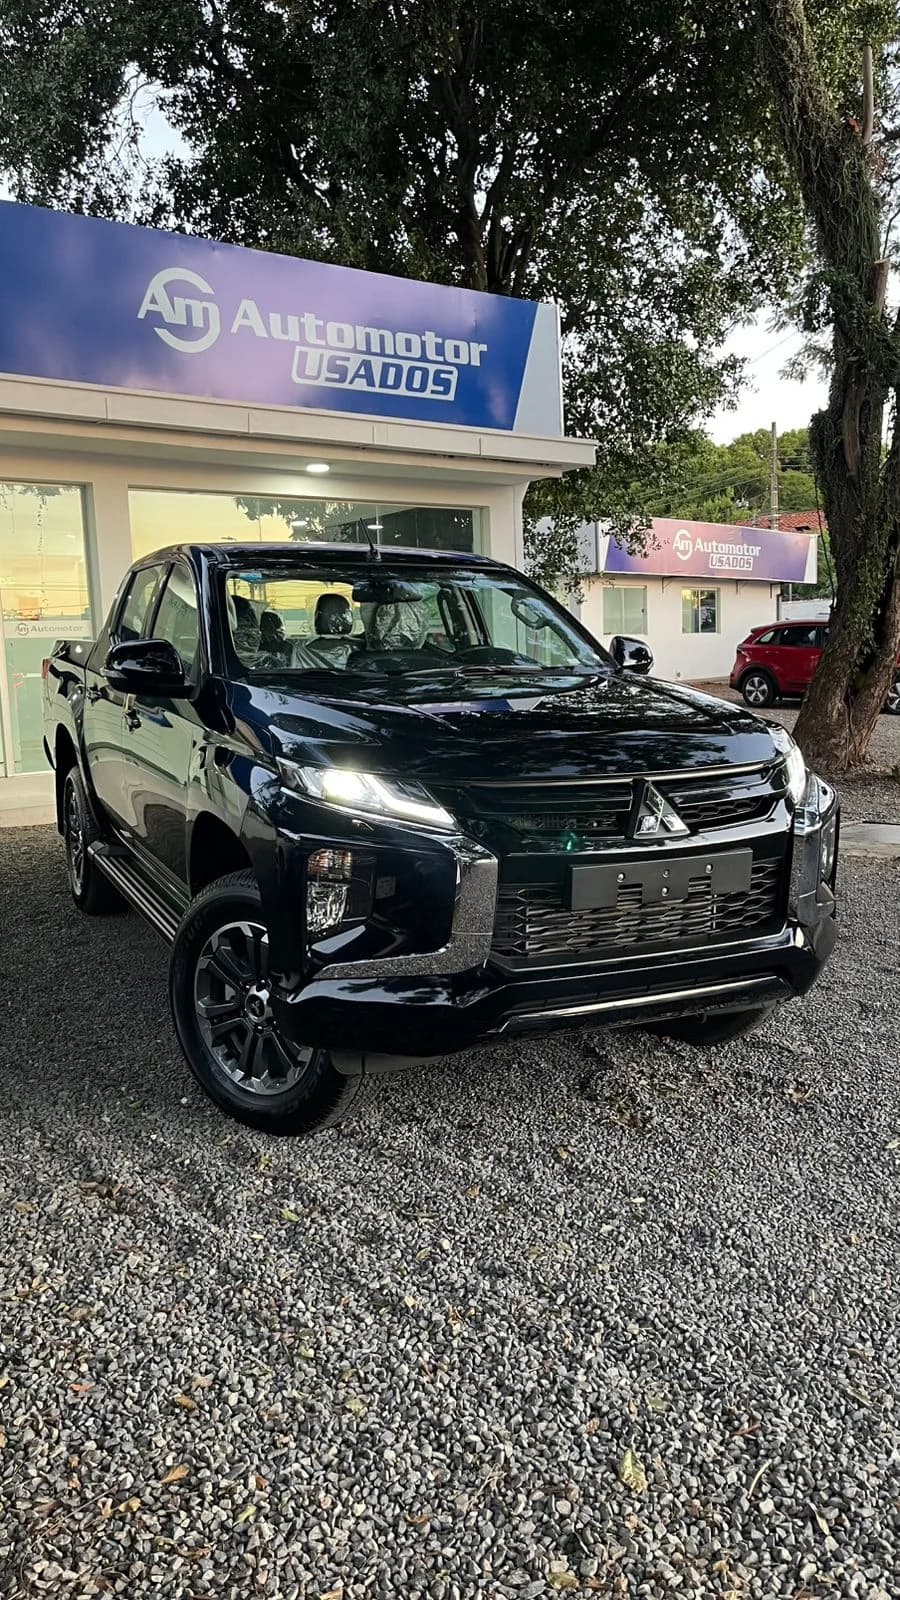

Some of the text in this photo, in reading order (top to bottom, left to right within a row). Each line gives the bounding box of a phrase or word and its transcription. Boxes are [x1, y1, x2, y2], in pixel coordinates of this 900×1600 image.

[231, 299, 487, 366] Automotor
[300, 353, 453, 396] USADOS
[695, 539, 761, 556] Automotor
[711, 556, 752, 569] USADOS
[31, 625, 83, 633] Automotor
